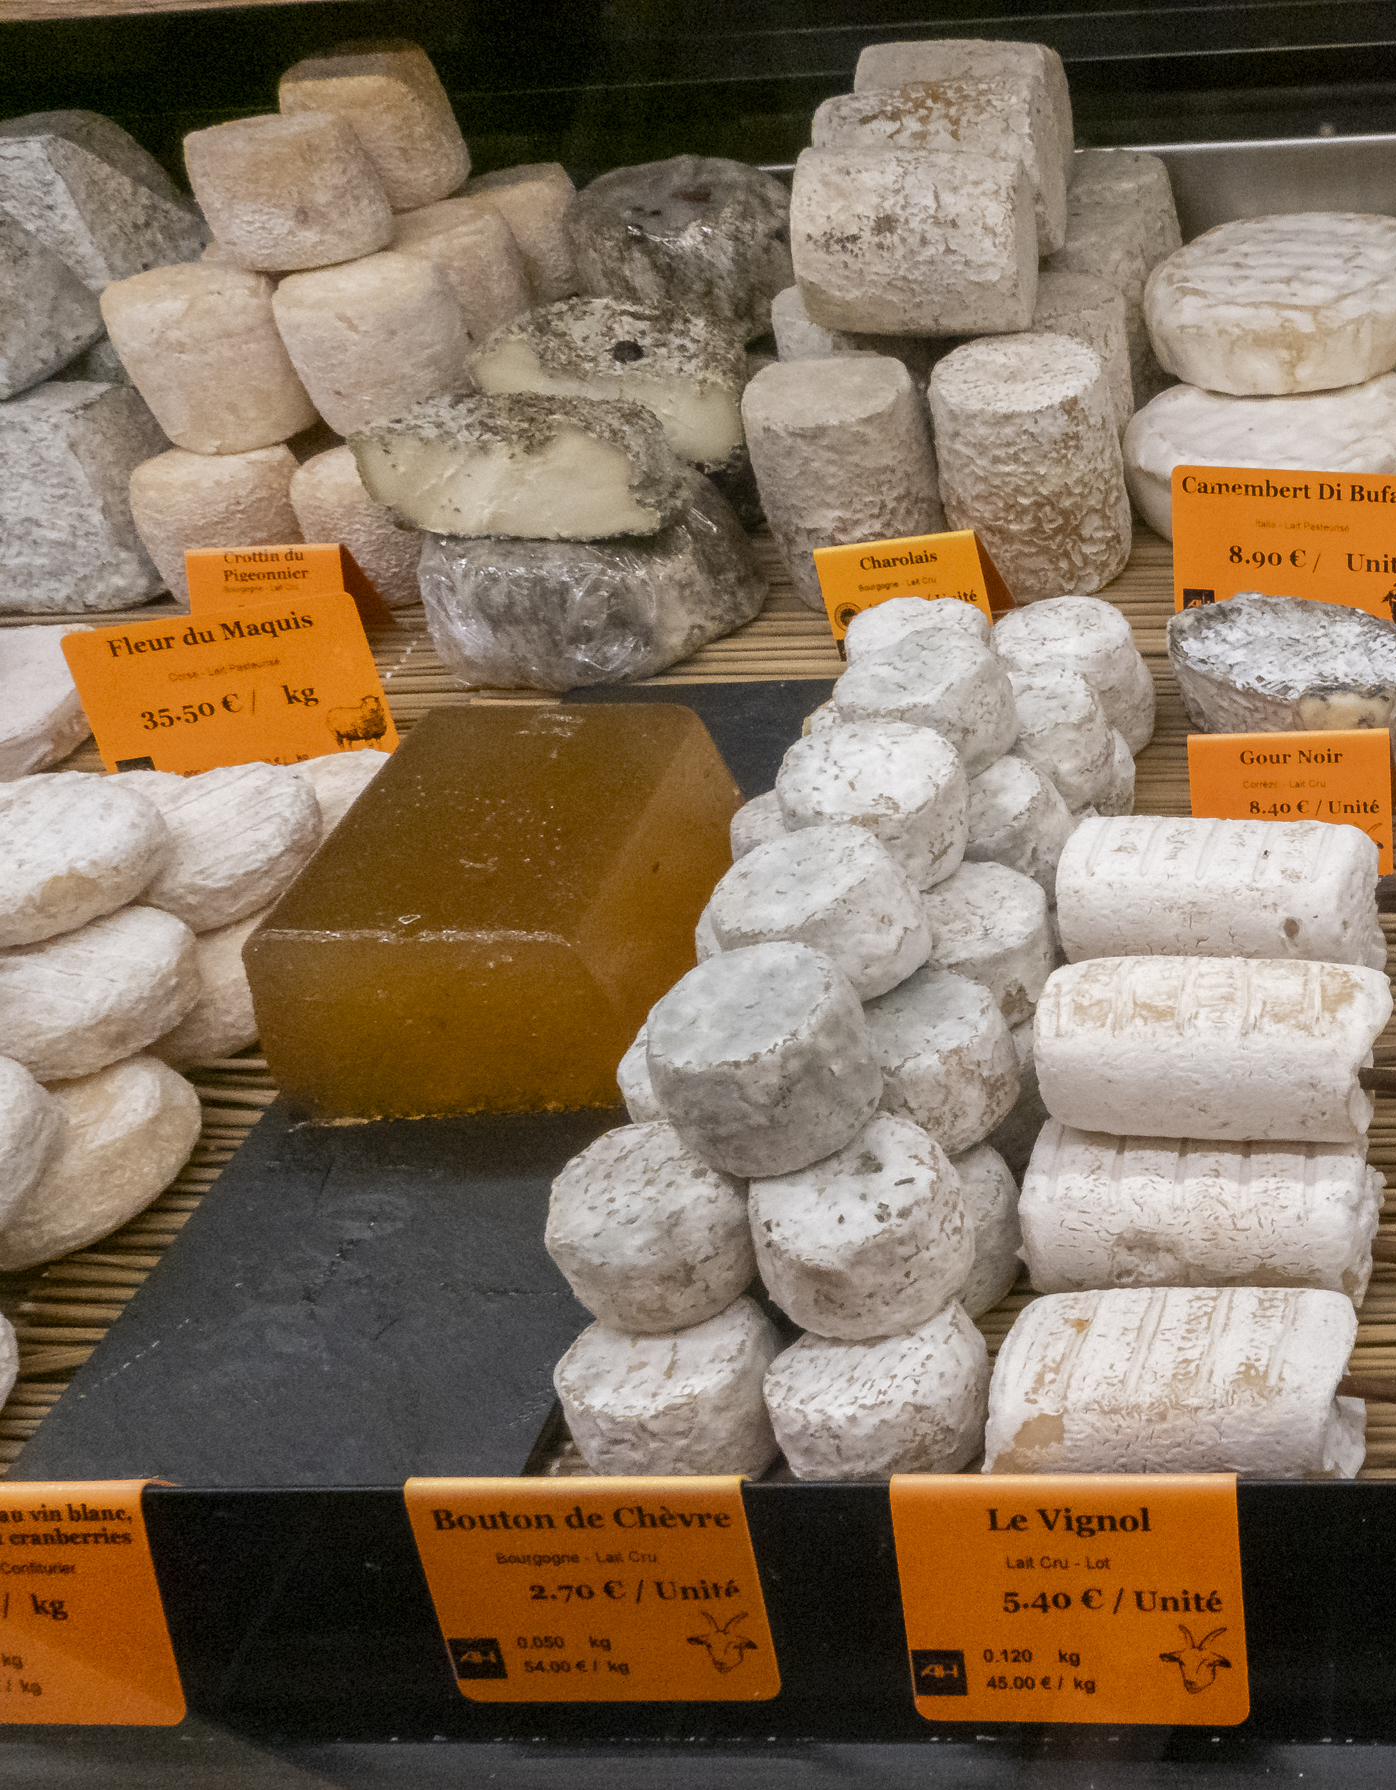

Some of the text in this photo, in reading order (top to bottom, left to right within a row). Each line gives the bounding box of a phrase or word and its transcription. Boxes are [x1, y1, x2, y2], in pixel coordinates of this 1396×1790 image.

[1182, 476, 1311, 500] Camembert
[1318, 483, 1342, 501] Di
[224, 548, 304, 564] Crottin du
[860, 550, 938, 570] Charolais
[1229, 545, 1282, 569] 8.90
[1290, 549, 1306, 568] €
[223, 567, 309, 582] Pigeonnier
[107, 611, 314, 658] Fleur du Maquis
[140, 702, 215, 731] 35.50
[222, 694, 244, 714] €
[281, 684, 320, 708] kg
[1240, 748, 1344, 766] Gour Noir
[1288, 780, 1306, 789] Lait
[1308, 780, 1326, 788] Cru
[1250, 800, 1291, 816] 8.40
[1328, 798, 1380, 814] Unité
[28, 1504, 62, 1522] vin
[65, 1503, 132, 1525] blanc,
[431, 1505, 732, 1531] Bouton de Chèvre
[986, 1507, 1151, 1538] Le Vignol
[9, 1527, 132, 1545] cranberries
[496, 1552, 580, 1567] Bourgogne
[596, 1551, 624, 1563] Lait
[628, 1550, 658, 1563] Cru
[1006, 1556, 1035, 1570] Lait
[1040, 1556, 1069, 1570] Cru
[1086, 1556, 1111, 1570] Lot
[529, 1584, 595, 1602] 2.70
[604, 1580, 626, 1600] €
[653, 1579, 742, 1601] Unité
[29, 1593, 68, 1620] kg
[1003, 1590, 1072, 1614] 5.40
[1081, 1588, 1104, 1611] €
[1134, 1589, 1224, 1613] Unité
[516, 1636, 612, 1652] 0.050 kg
[982, 1648, 1081, 1668] 0.120 kg
[607, 1661, 630, 1676] kg
[986, 1676, 1036, 1690] 45.00
[1040, 1676, 1053, 1690] €
[1074, 1676, 1096, 1694] kg
